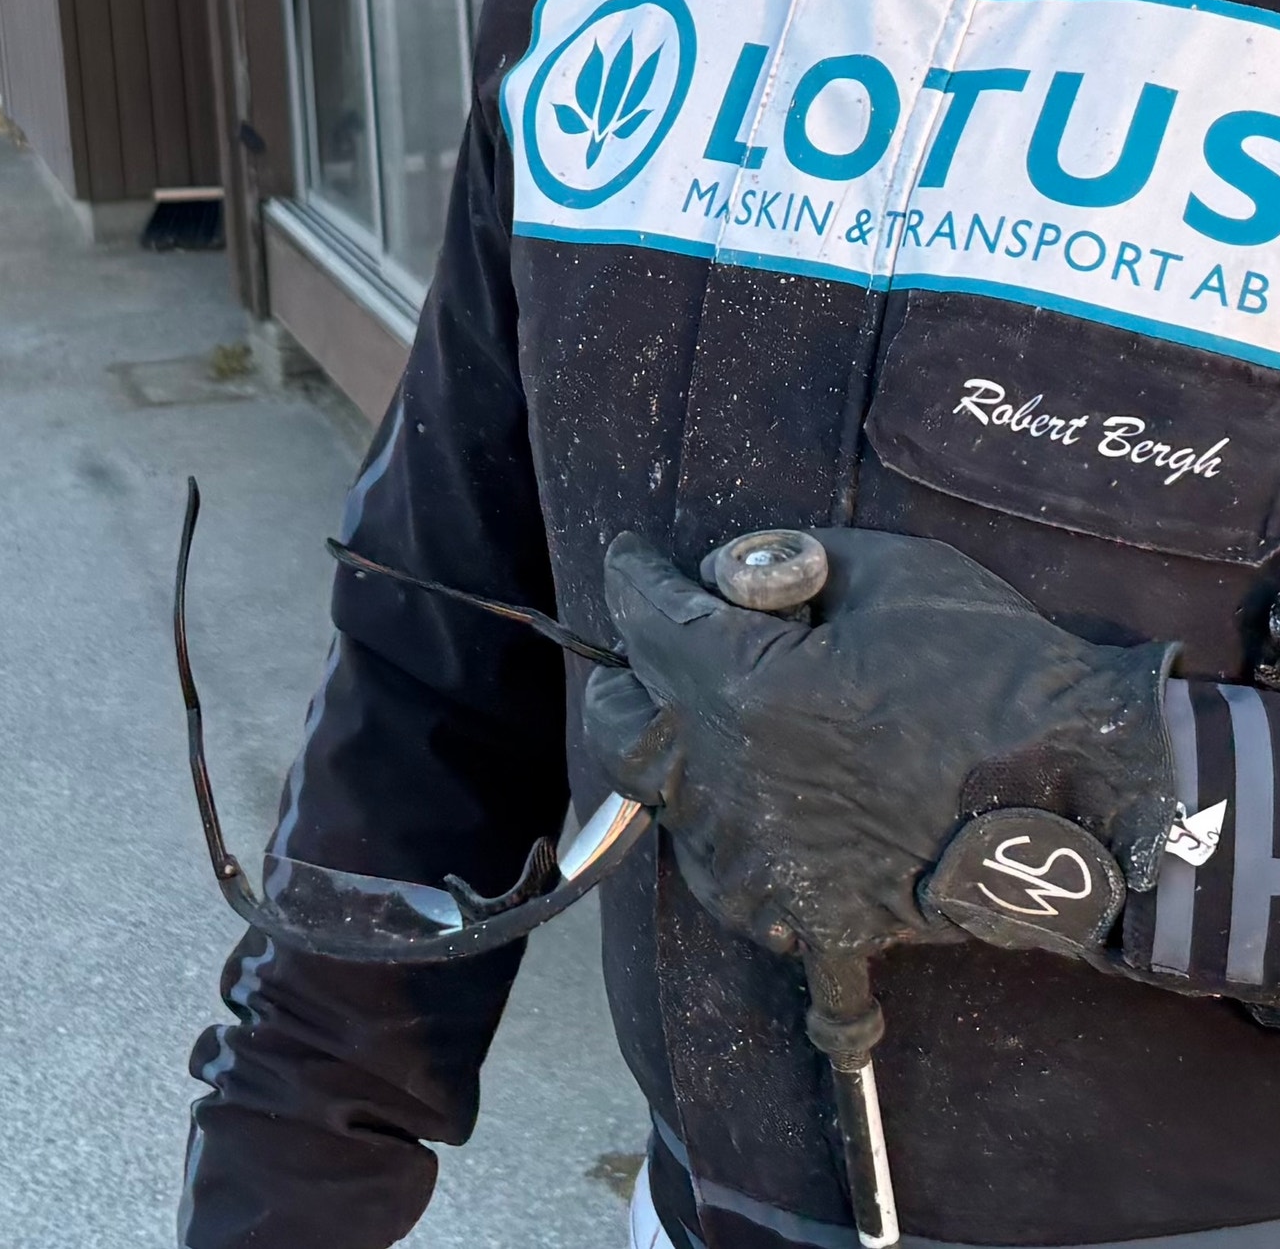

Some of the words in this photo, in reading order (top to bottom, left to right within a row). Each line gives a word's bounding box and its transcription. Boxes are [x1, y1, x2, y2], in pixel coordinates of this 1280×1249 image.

[681, 177, 835, 237] MASKIN
[845, 208, 875, 247] &
[885, 209, 1184, 293] TRANSPORT
[1190, 263, 1271, 315] AB
[952, 378, 1090, 446] Robert
[1097, 416, 1231, 486] Bergh
